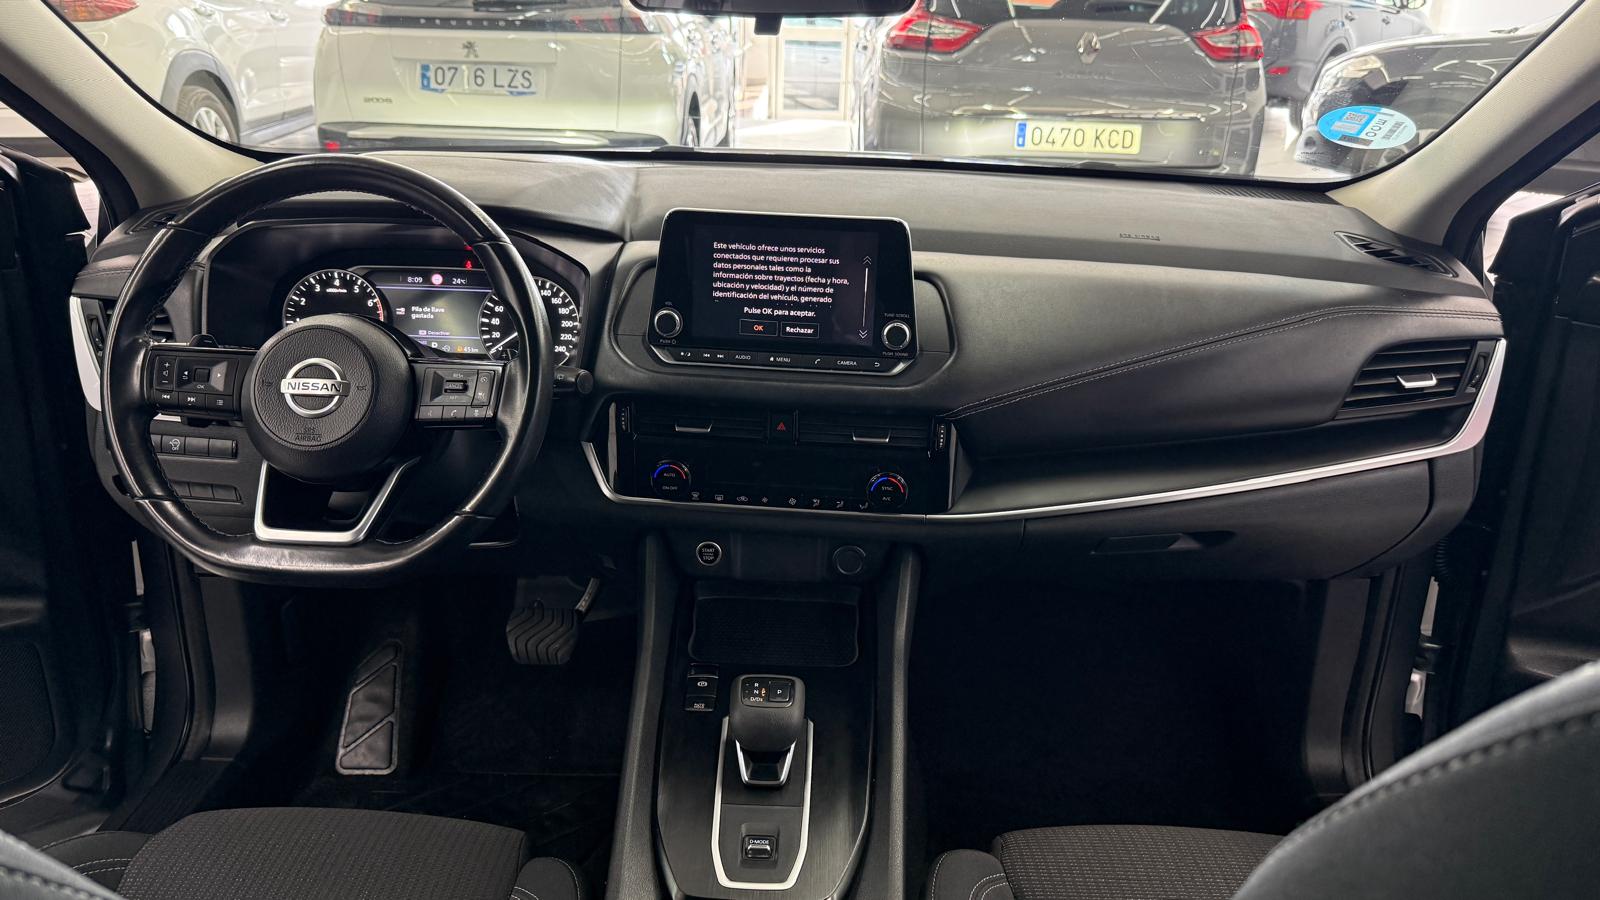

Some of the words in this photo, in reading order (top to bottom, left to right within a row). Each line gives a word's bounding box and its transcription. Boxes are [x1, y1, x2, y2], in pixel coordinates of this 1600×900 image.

[494, 67, 533, 89] LZS
[1031, 126, 1085, 148] 0470
[1094, 128, 1134, 149] KCD
[713, 241, 727, 249] Este
[797, 246, 826, 254] servicios
[713, 252, 751, 260] conectados
[766, 255, 799, 263] requieren
[732, 263, 768, 271] personales
[769, 264, 785, 272] tales
[713, 271, 754, 280] información
[774, 274, 804, 283] trayectos
[805, 275, 826, 284] (fecha
[832, 276, 850, 286] hora,
[314, 284, 320, 292] 3
[353, 285, 359, 293] 5
[712, 280, 745, 289] ubicación
[750, 283, 785, 291] velocidad)
[798, 285, 825, 293] número
[712, 290, 758, 299] identificación
[758, 292, 769, 300] del
[300, 297, 306, 305] 2
[367, 299, 373, 307] 6
[494, 305, 504, 313] 60
[743, 306, 761, 314] Pulse
[762, 307, 773, 315] OK
[561, 320, 573, 328] 200
[785, 326, 814, 334] Rechazar
[287, 381, 341, 393] NISSAN
